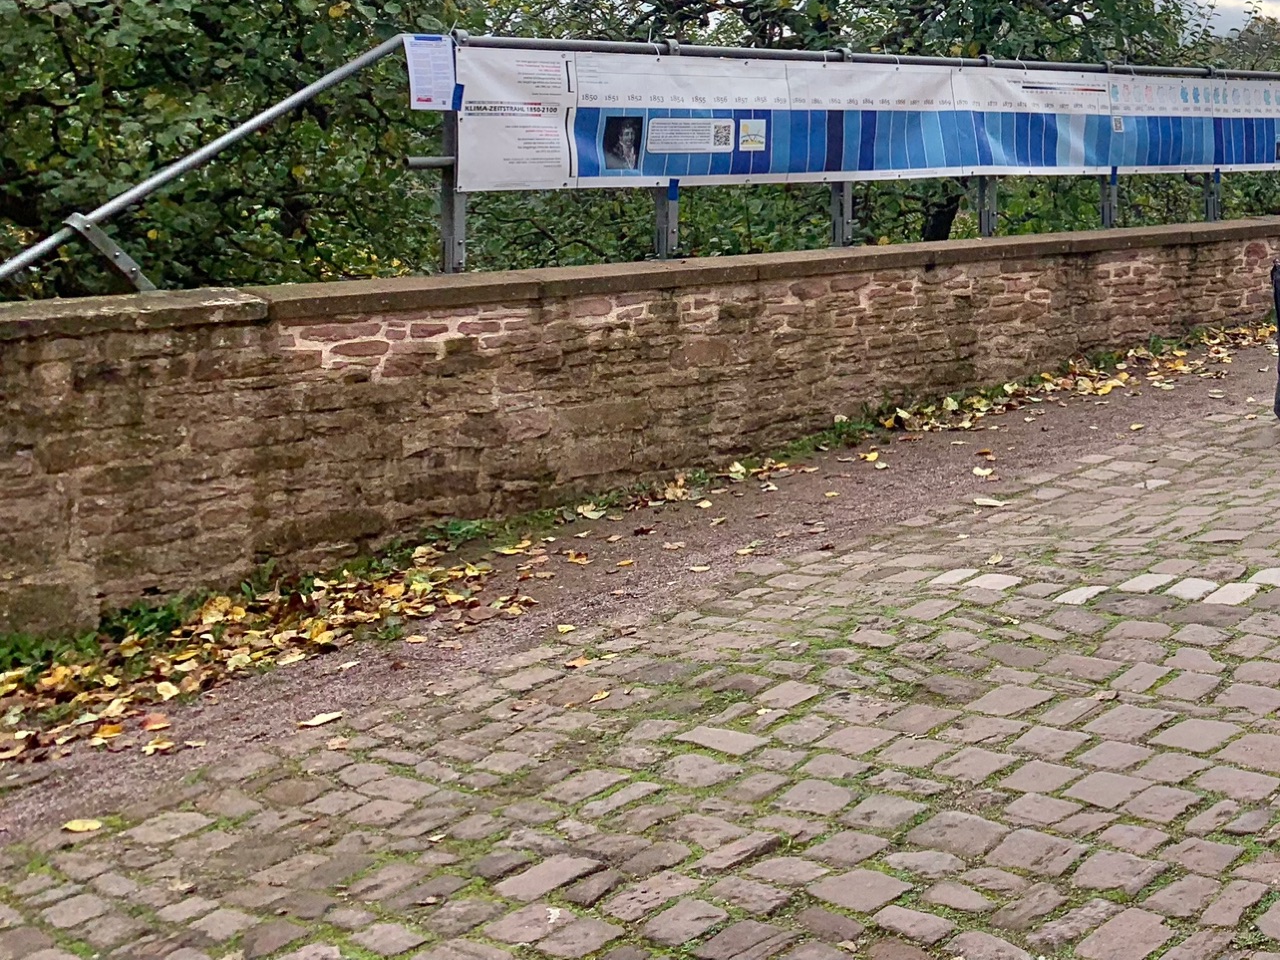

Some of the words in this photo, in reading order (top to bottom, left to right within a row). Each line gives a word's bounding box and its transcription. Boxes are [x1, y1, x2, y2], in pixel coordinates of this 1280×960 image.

[582, 94, 598, 102] 1850
[670, 95, 684, 103] 1854
[692, 95, 706, 103] 1855
[464, 105, 525, 113] KLIMA-ZEITSTRAHL
